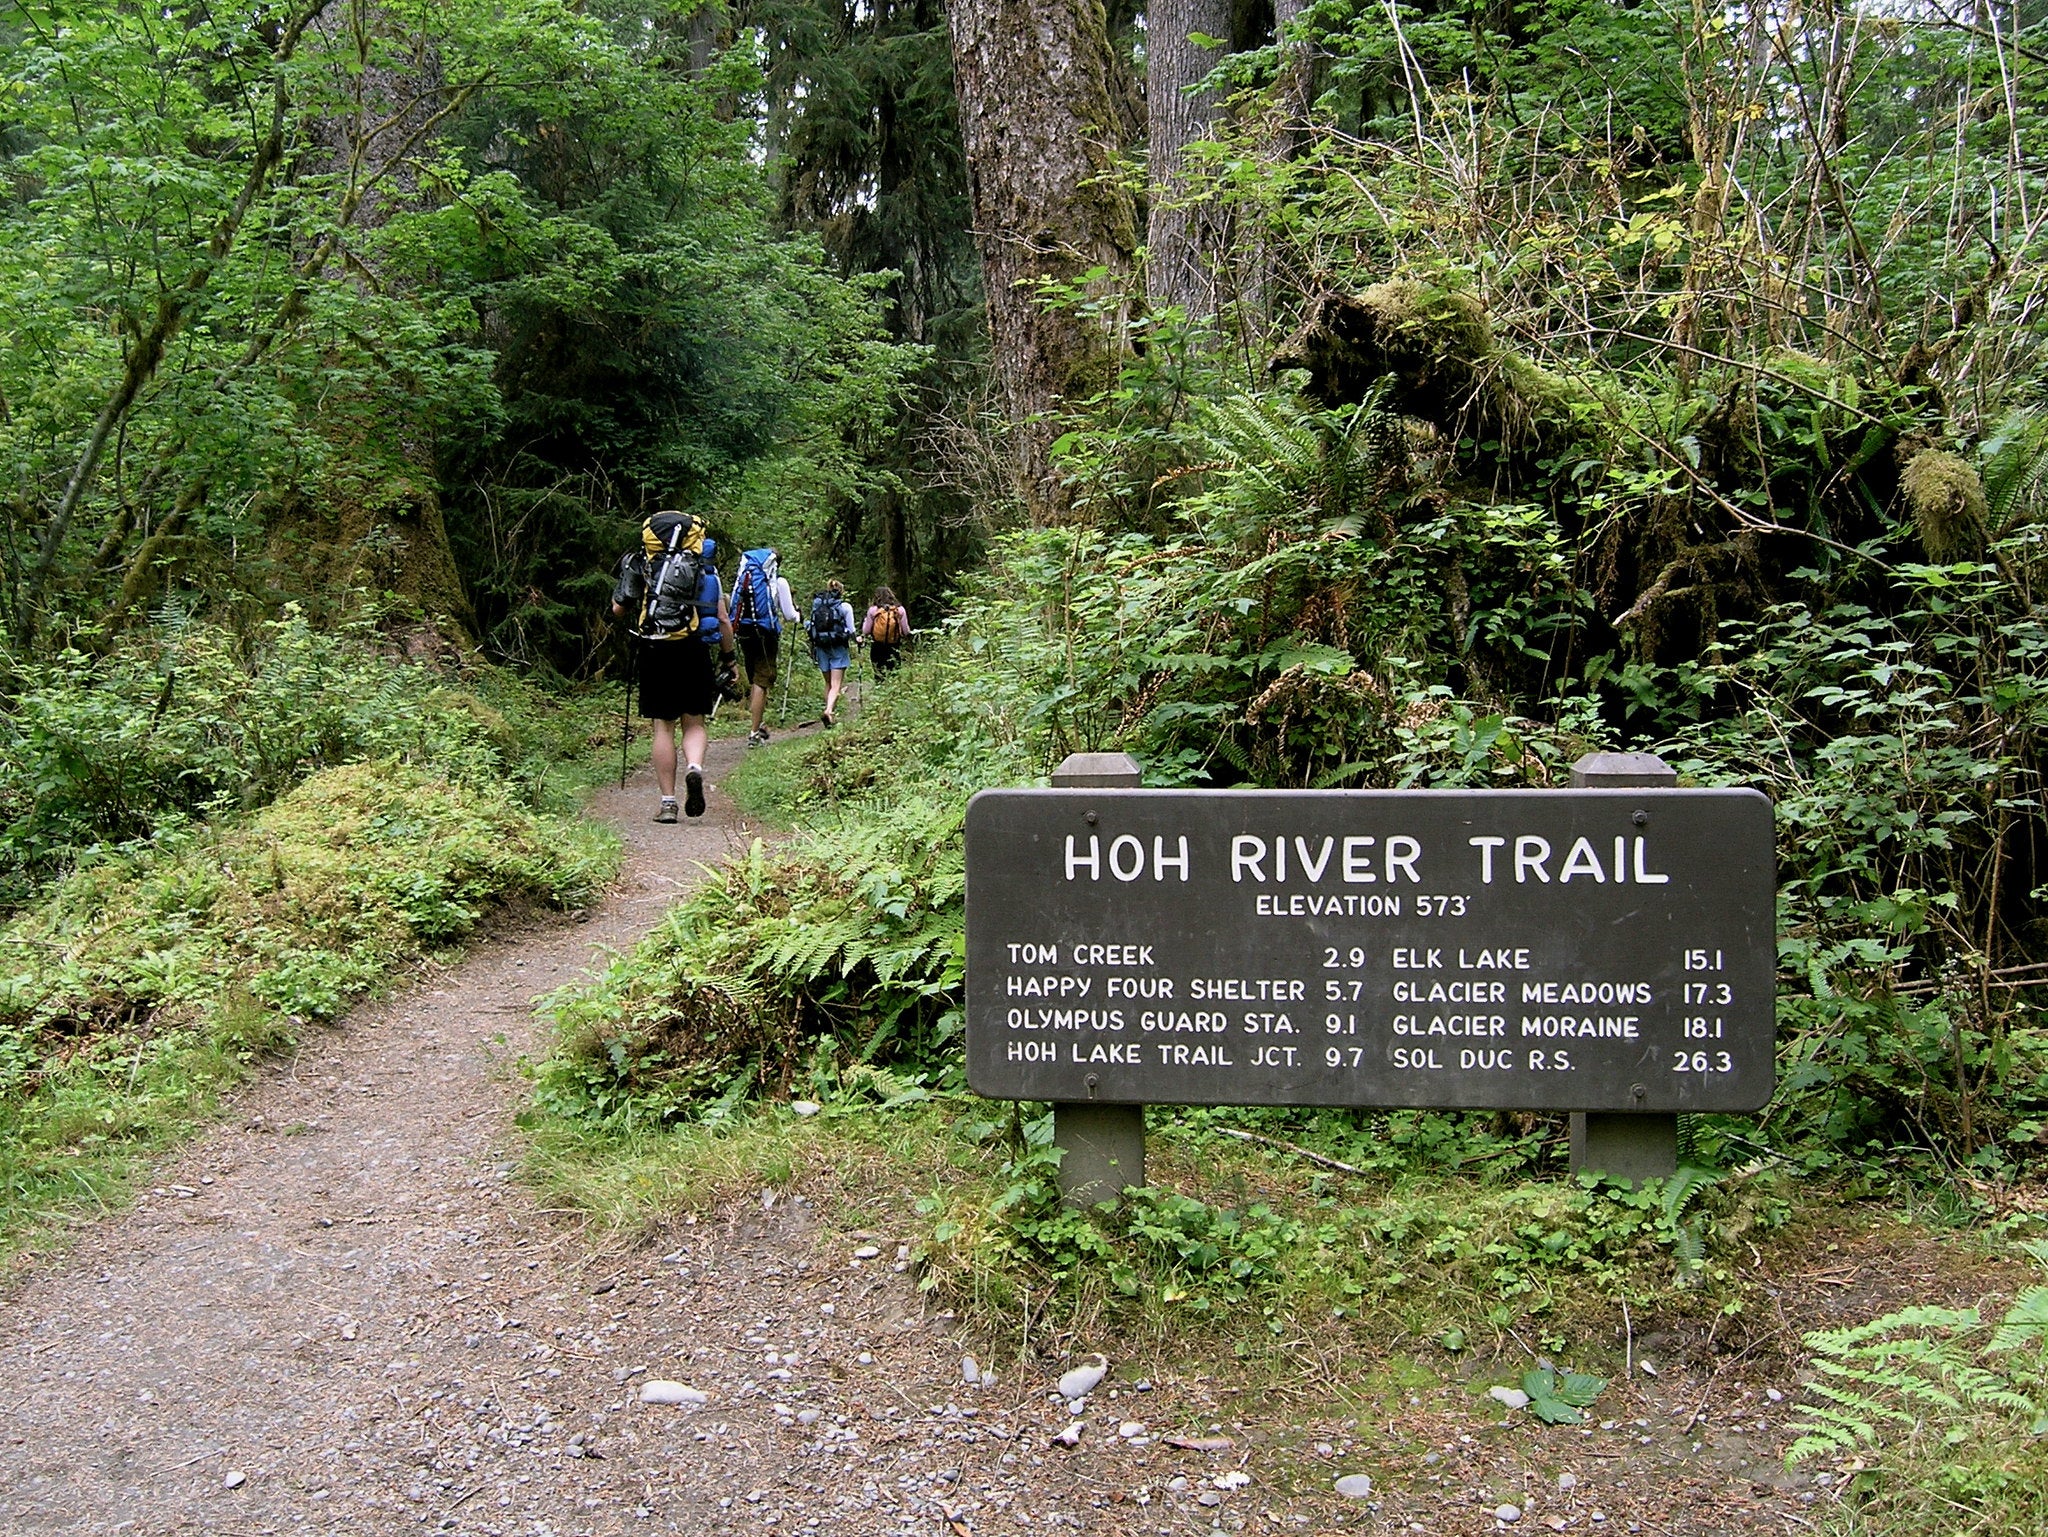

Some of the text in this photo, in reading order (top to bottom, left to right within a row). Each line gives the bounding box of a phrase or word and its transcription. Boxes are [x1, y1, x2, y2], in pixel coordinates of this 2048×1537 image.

[1064, 834, 1669, 884] HOH RIVER TRAIL
[1256, 894, 1400, 917] ELEVATION
[1006, 942, 1365, 968] TOM CREEK 2.9
[1392, 947, 1722, 971] ELK LAKE 15.1
[1007, 975, 1363, 1002] HAPPY FOUR SHELTER 5.7
[1392, 981, 1732, 1005] GLACIER MEADOWS 17.3
[1007, 1008, 1355, 1035] OLYMPUS GUARD STA. 9.1
[1392, 1014, 1722, 1039] GLACIER MORAINE 18.1
[1007, 1041, 1364, 1068] HOH LAKE TRAIL JCT. 9.7
[1392, 1047, 1732, 1072] SOL DUC R.S. 26.3
